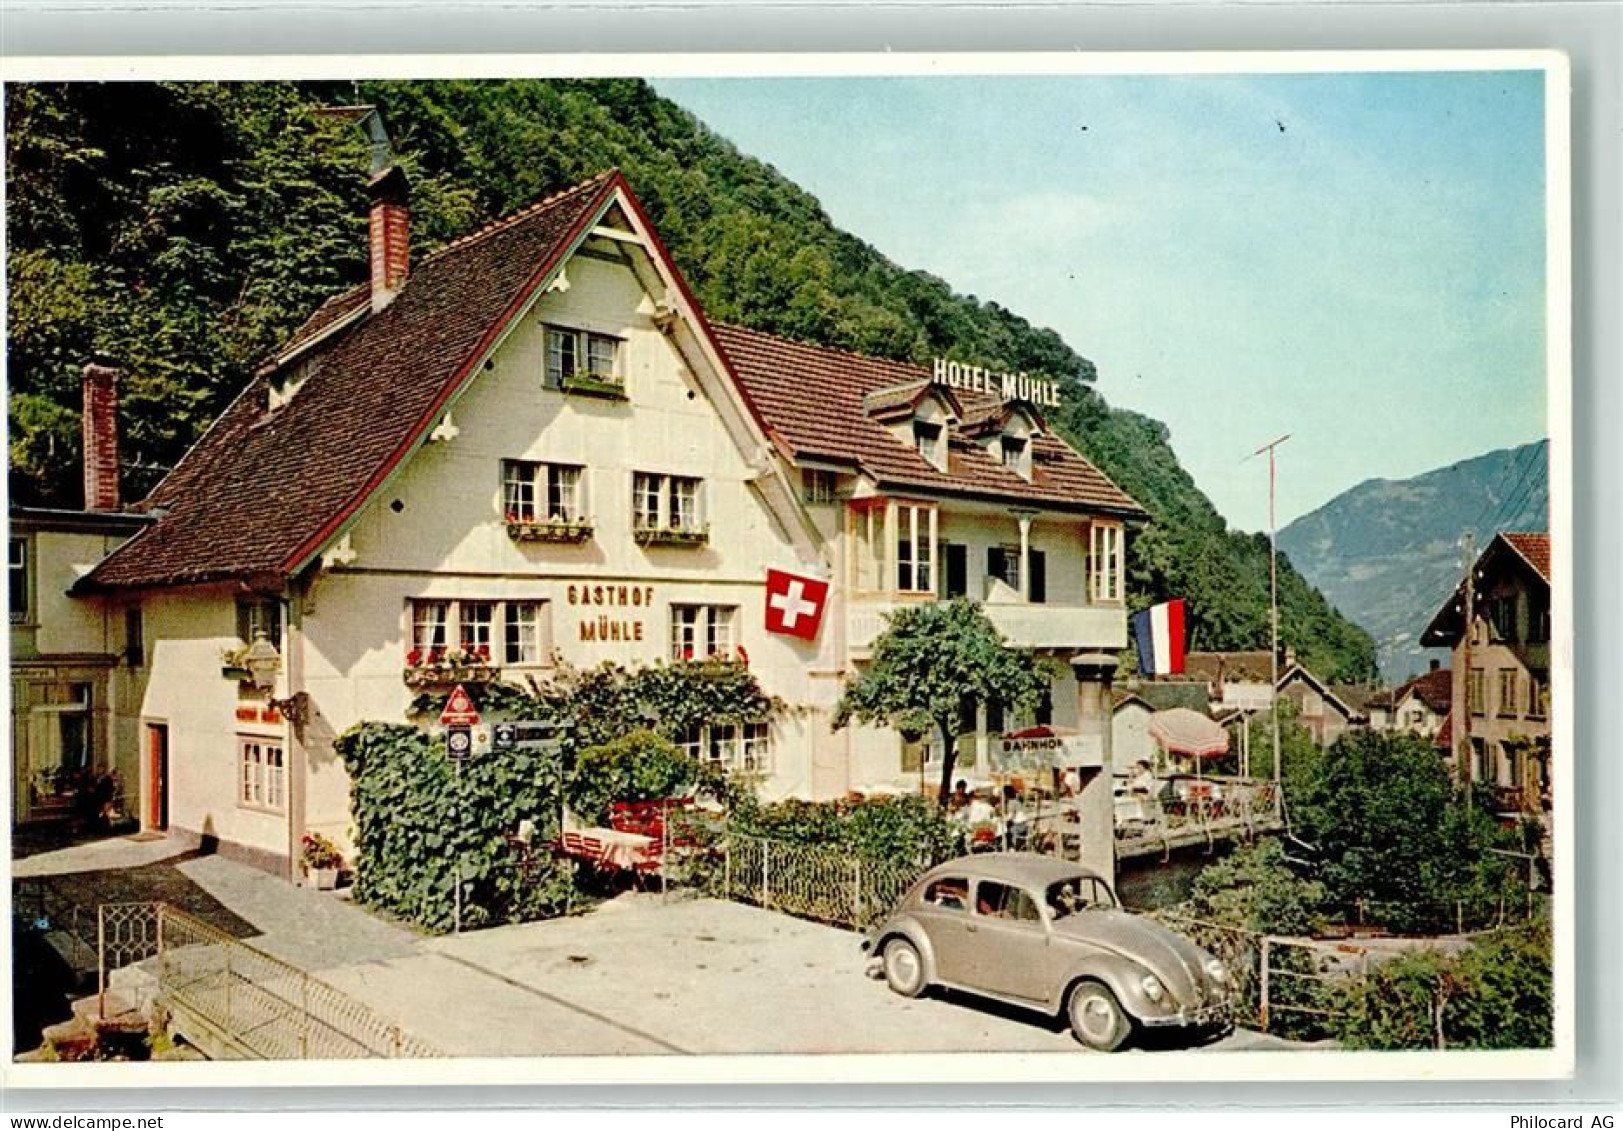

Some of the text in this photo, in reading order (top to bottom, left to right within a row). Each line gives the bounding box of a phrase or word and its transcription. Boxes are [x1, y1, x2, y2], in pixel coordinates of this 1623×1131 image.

[933, 357, 993, 394] HOTEL
[567, 585, 654, 607] GASTHOF
[580, 614, 643, 641] MÜHLE
